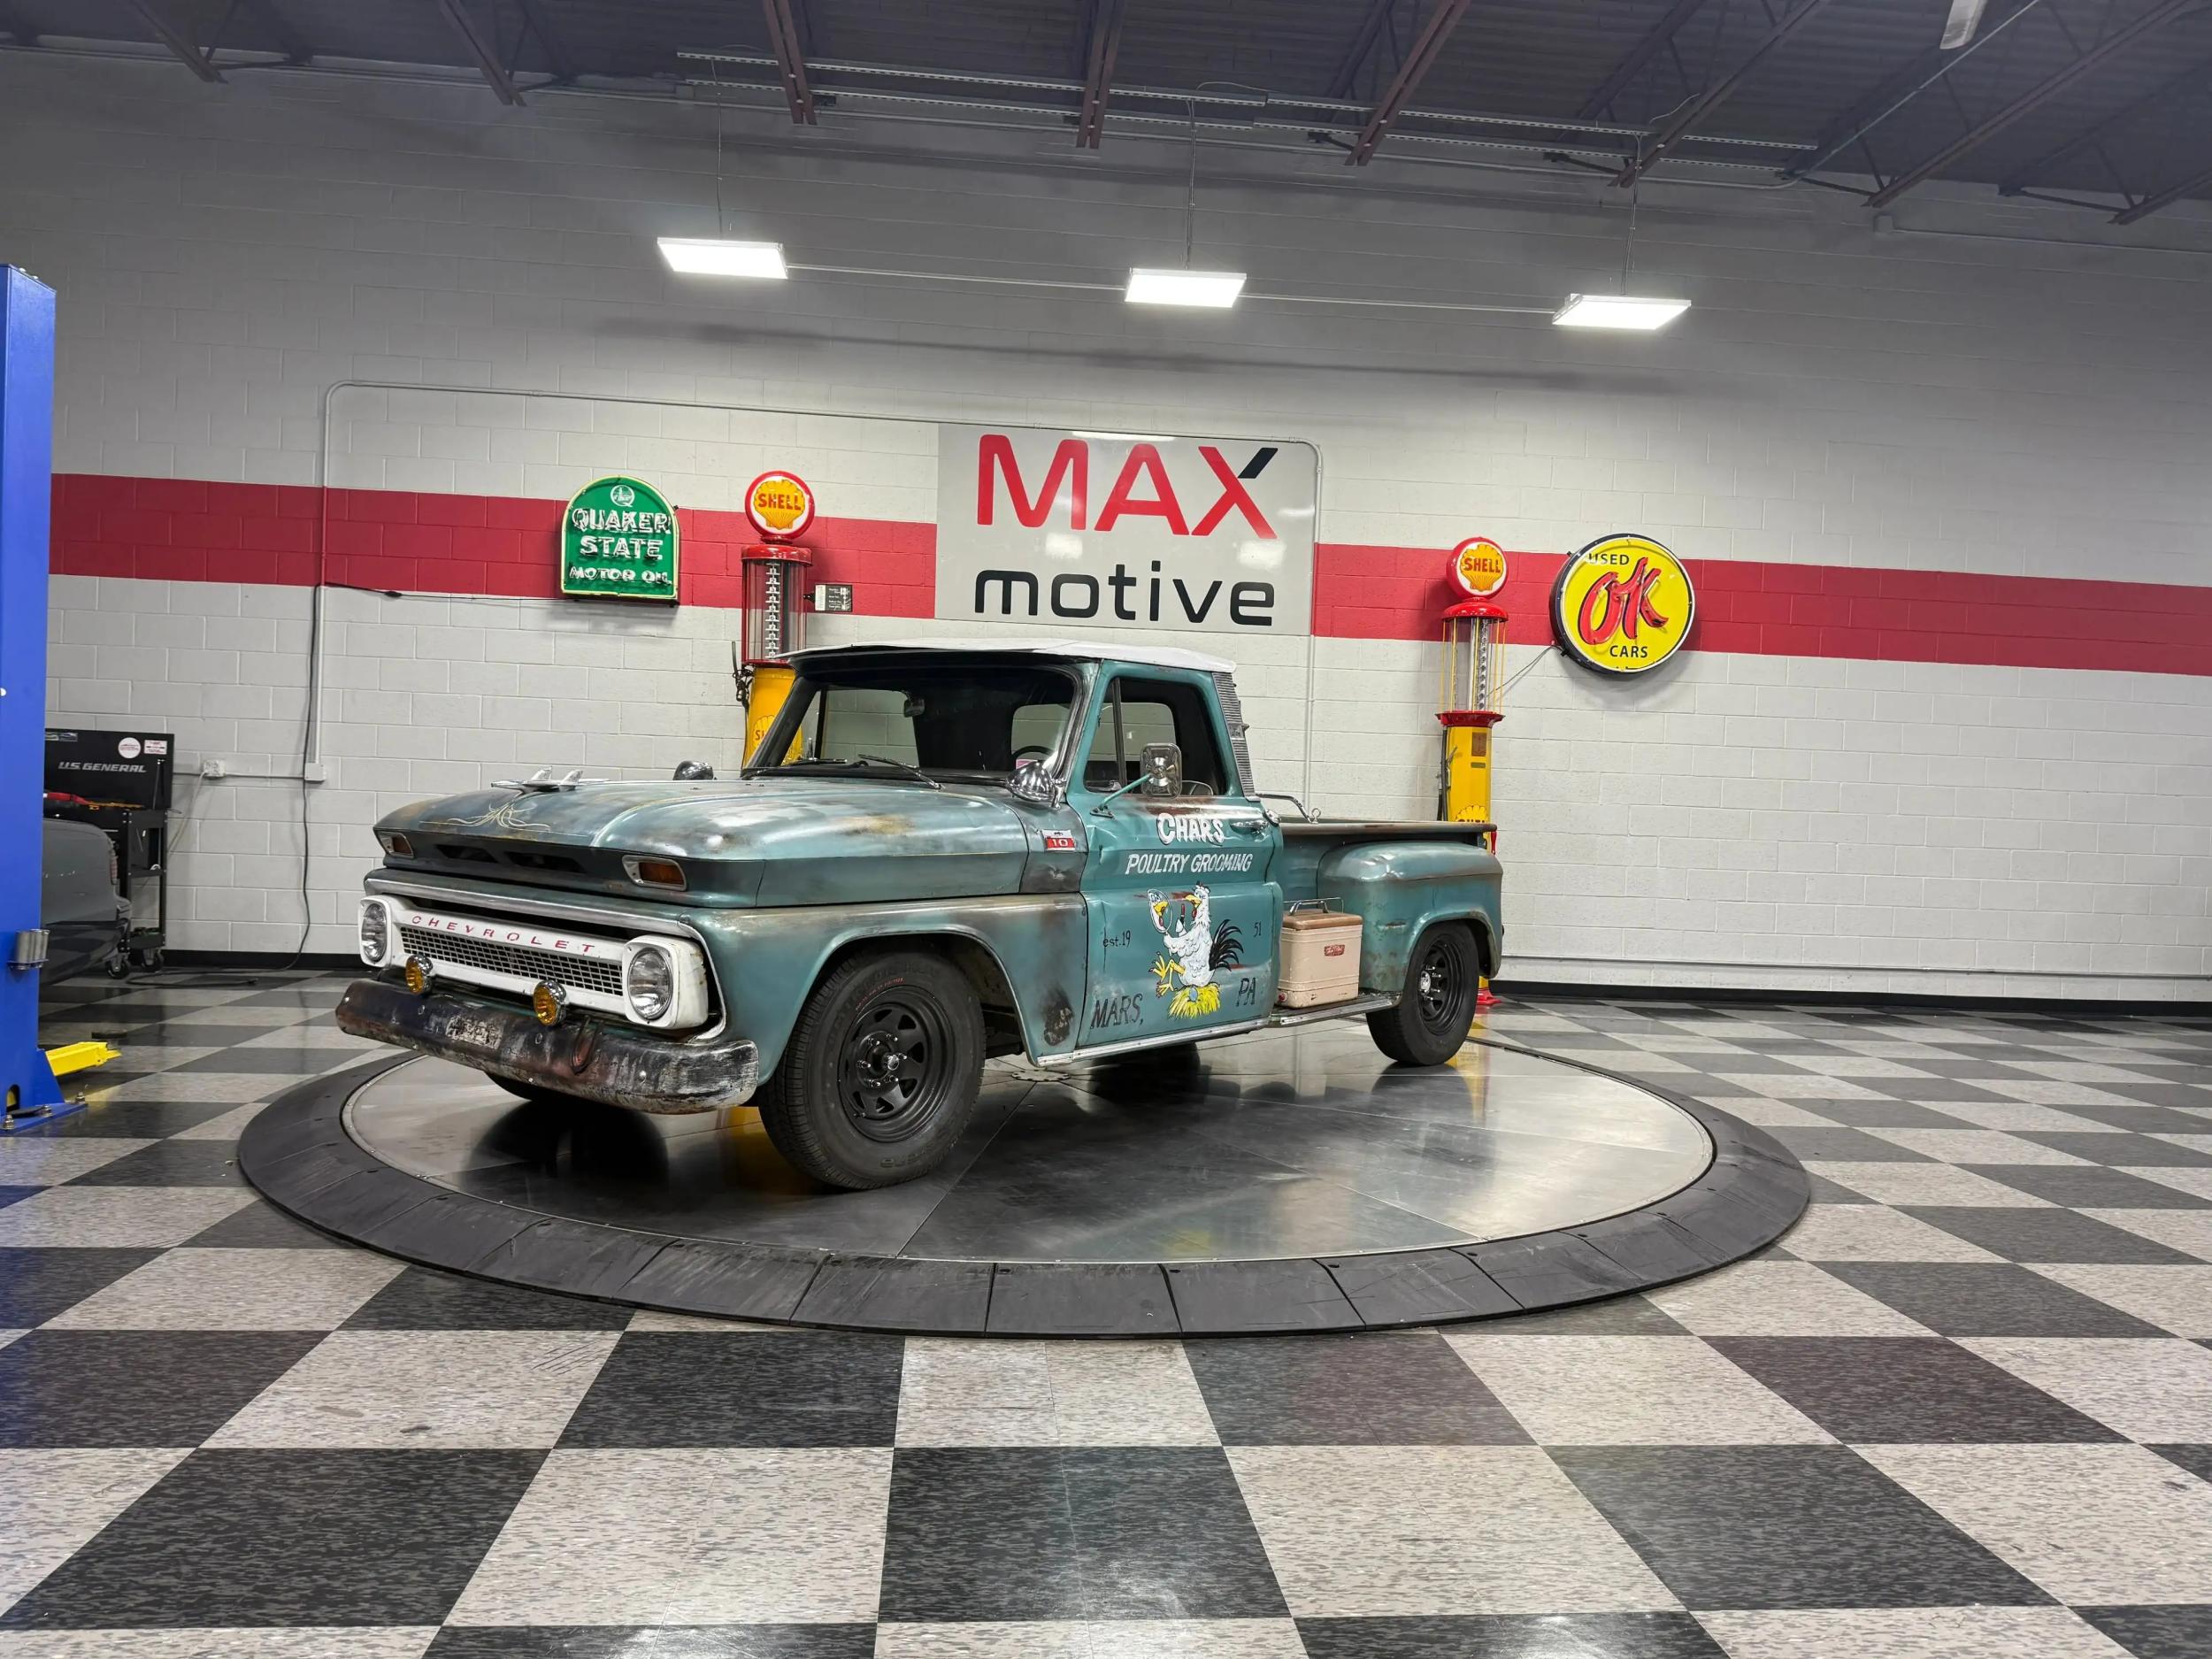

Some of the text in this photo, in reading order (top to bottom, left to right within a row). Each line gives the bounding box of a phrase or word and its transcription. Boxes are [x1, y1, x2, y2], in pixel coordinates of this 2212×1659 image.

[977, 434, 1279, 539] MAX
[757, 493, 802, 511] SHELL
[572, 508, 672, 534] QUAKER
[580, 534, 664, 560] STATE
[1463, 557, 1501, 573] SHELL
[1588, 552, 1630, 565] USED
[569, 565, 672, 586] MOTOR OIL
[974, 560, 1276, 626] motive
[1578, 557, 1669, 645] OK
[1609, 645, 1648, 658] CARS
[82, 764, 147, 773] GENERAL
[1156, 812, 1225, 847] CHARS
[1052, 838, 1068, 847] 10
[1125, 853, 1254, 875] POULTRY GROOMING
[411, 915, 595, 953] CHEVROLET
[1253, 921, 1262, 938] 51
[1090, 977, 1256, 1029] MARS, PA
